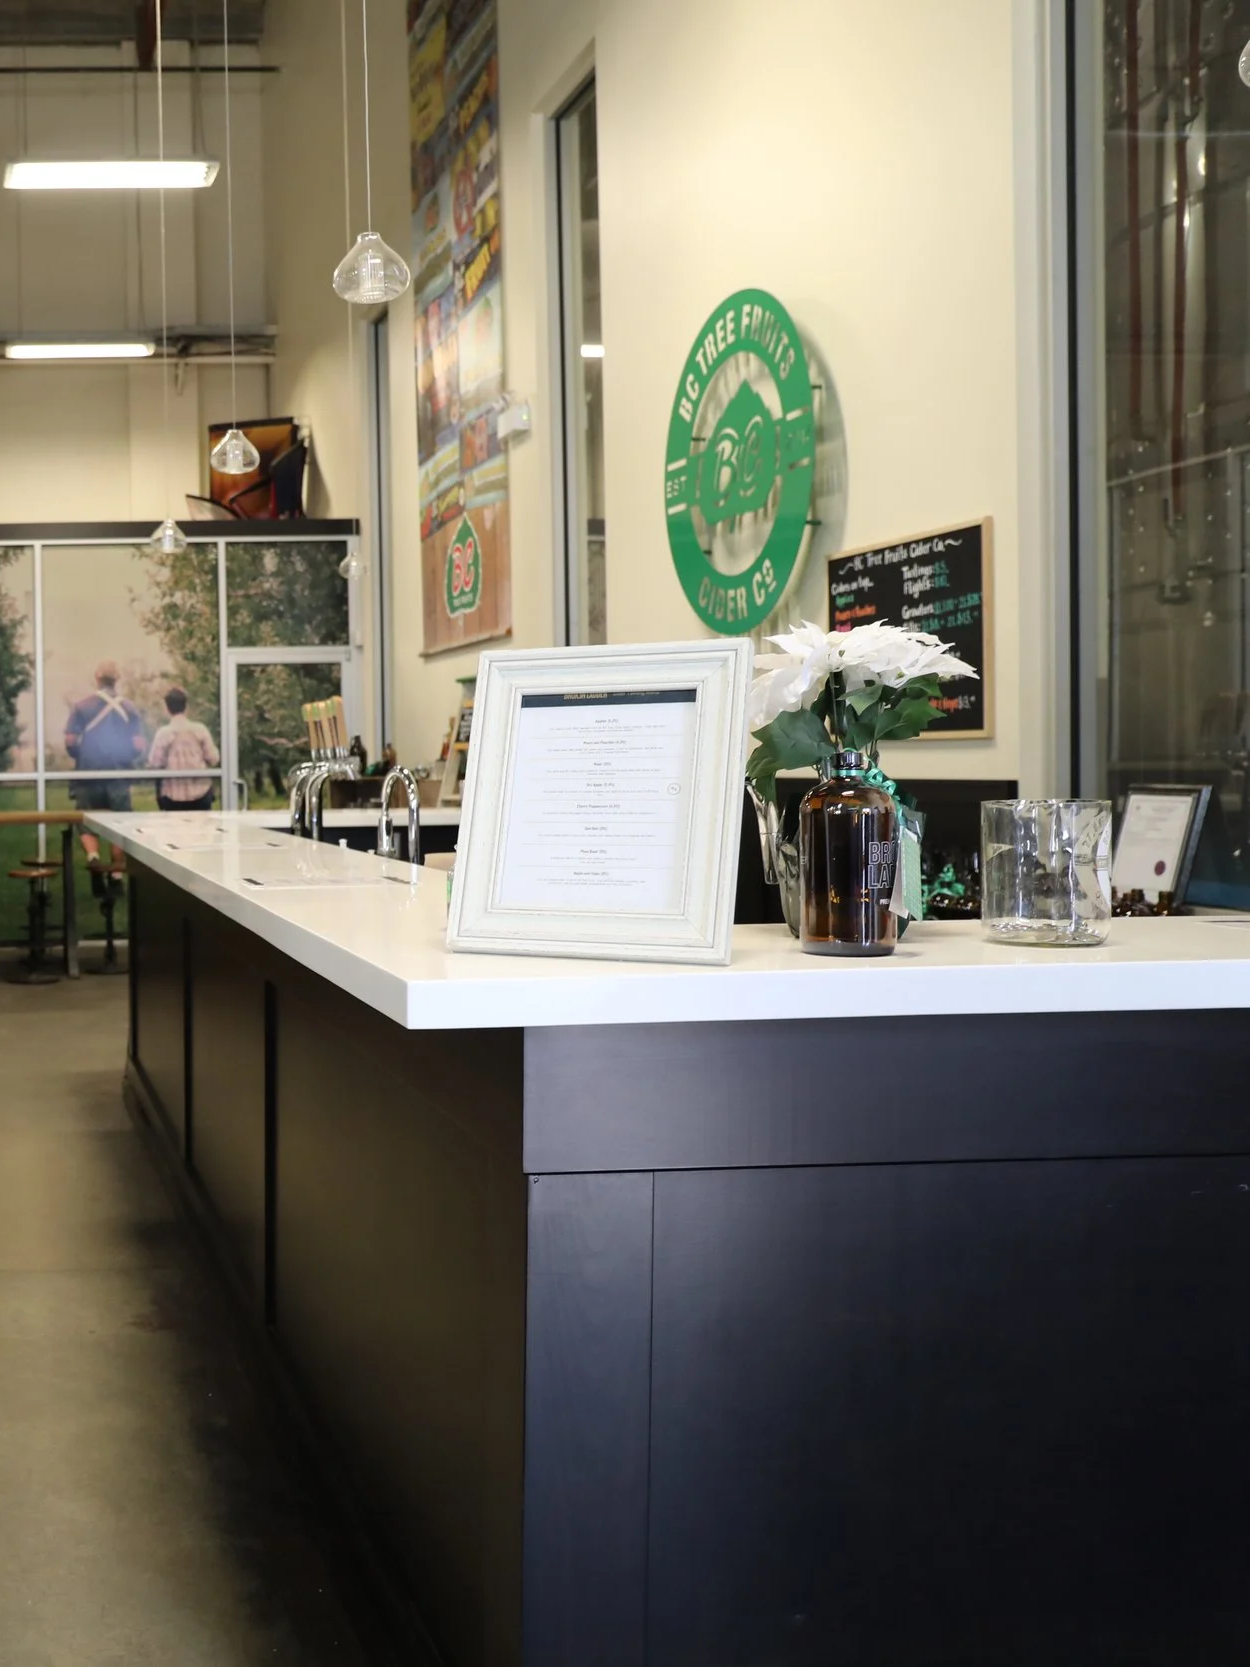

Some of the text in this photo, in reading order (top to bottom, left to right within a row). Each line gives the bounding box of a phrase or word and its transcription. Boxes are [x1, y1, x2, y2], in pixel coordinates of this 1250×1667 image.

[677, 303, 796, 423] BC TREE FRUITS
[452, 538, 475, 597] BC
[698, 575, 748, 623] CIDER
